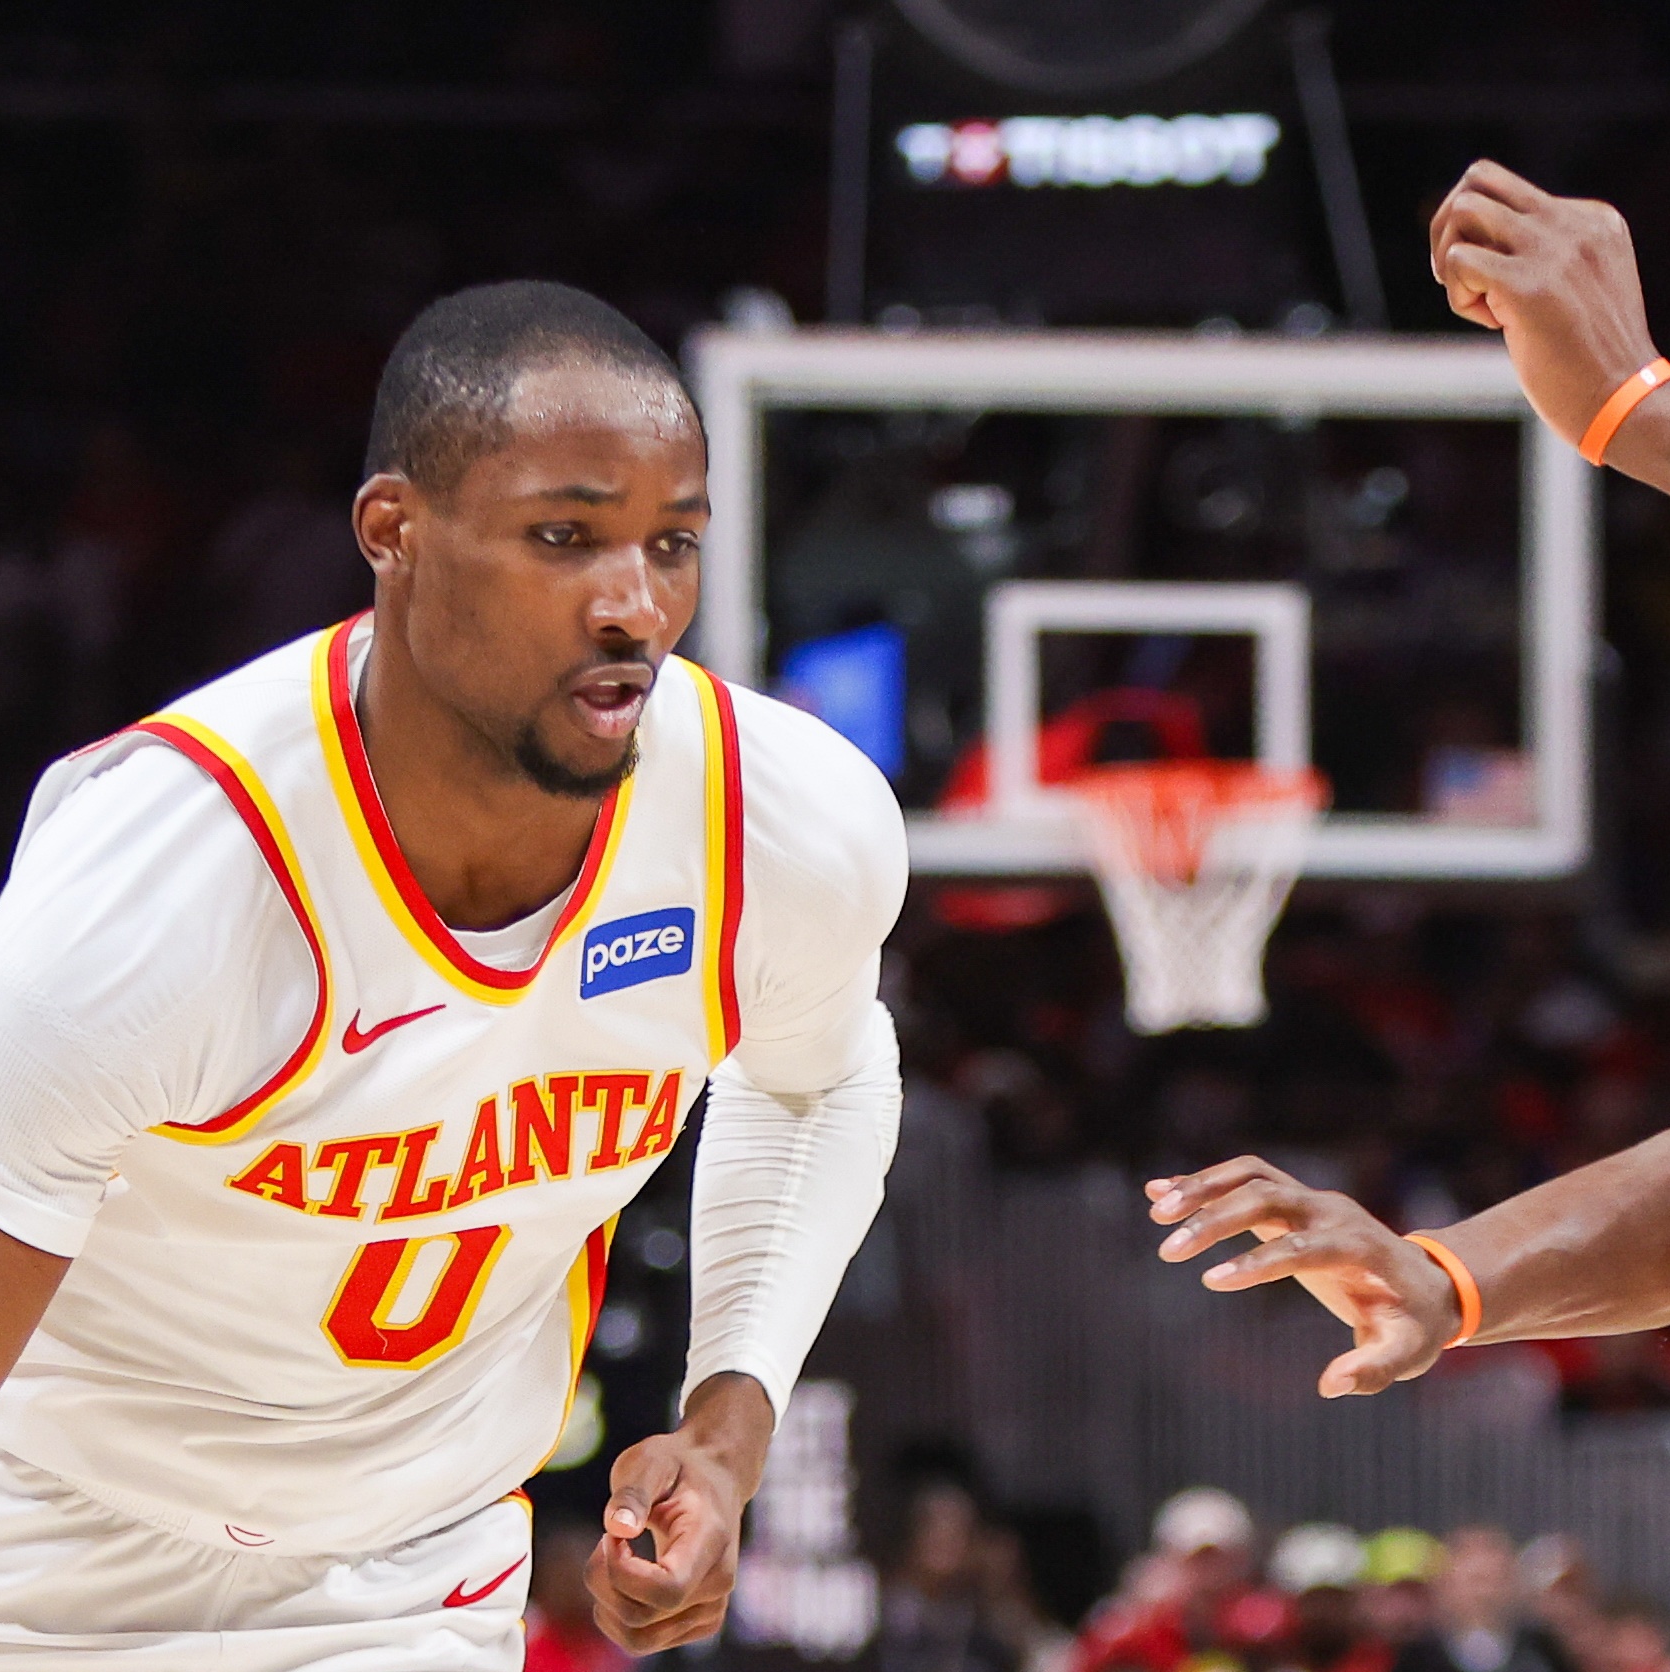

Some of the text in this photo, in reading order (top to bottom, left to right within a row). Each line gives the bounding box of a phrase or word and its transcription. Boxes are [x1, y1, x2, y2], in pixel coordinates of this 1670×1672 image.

[585, 922, 685, 983] paze
[224, 1066, 686, 1224] ATLANTA
[319, 1222, 514, 1371] 0
